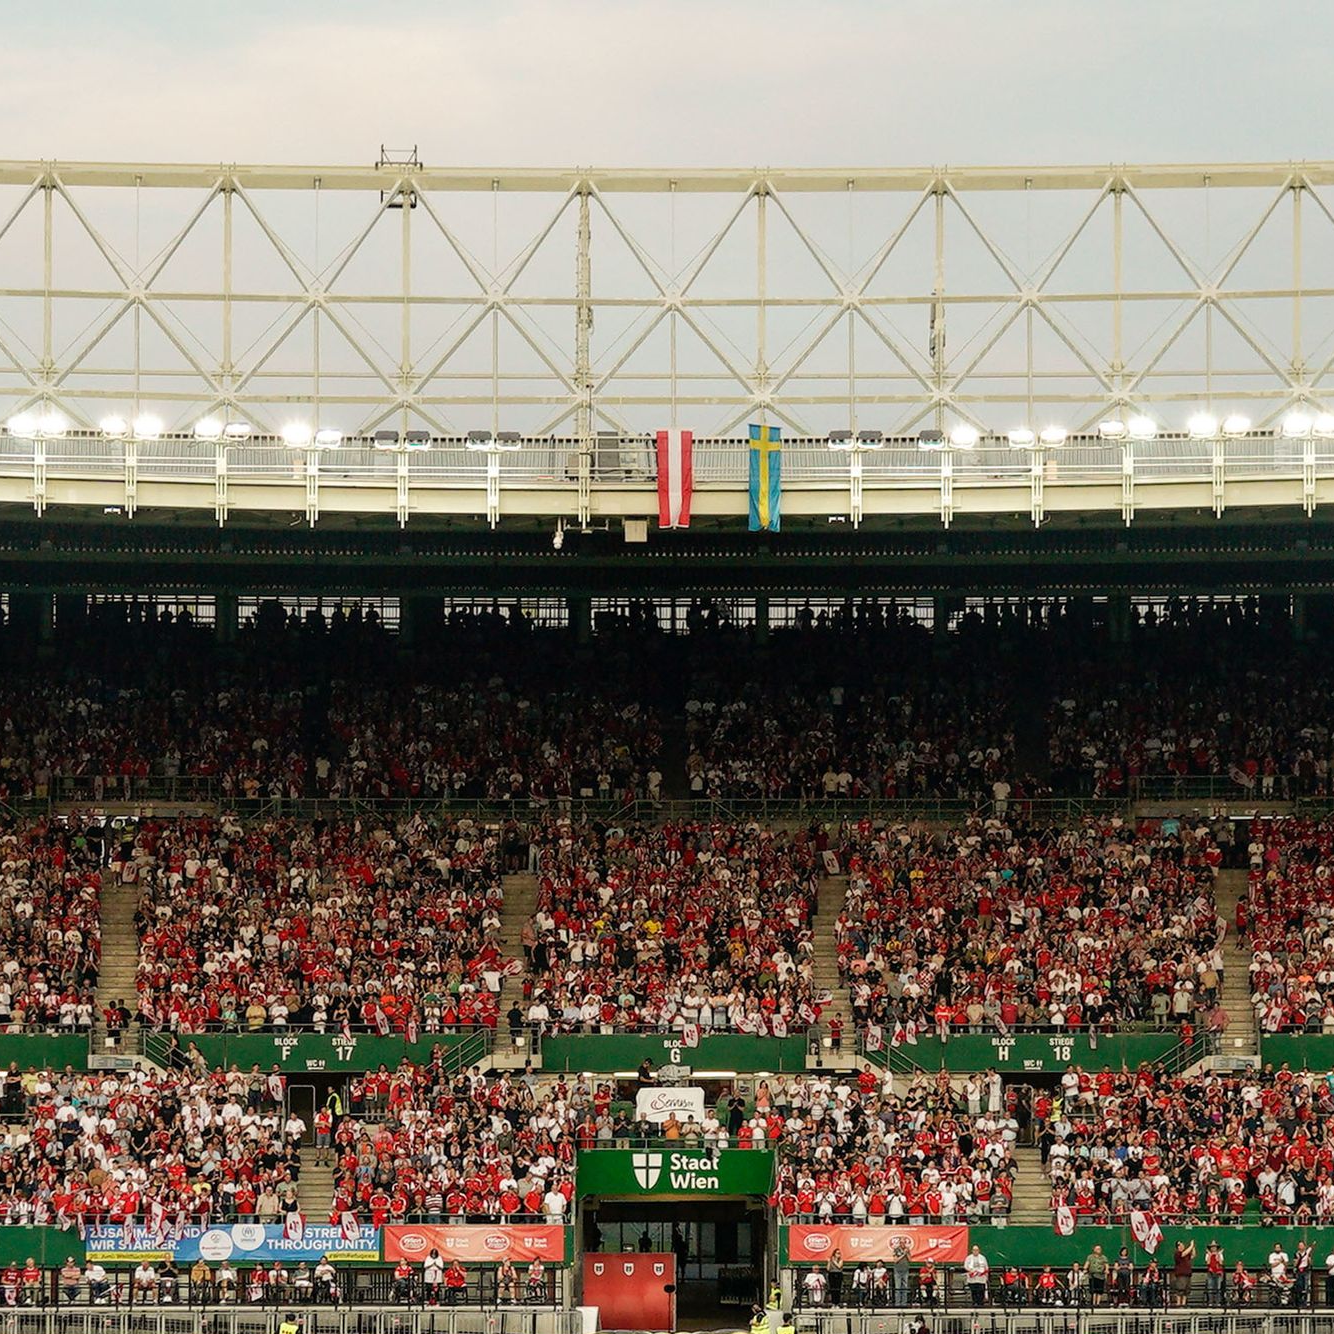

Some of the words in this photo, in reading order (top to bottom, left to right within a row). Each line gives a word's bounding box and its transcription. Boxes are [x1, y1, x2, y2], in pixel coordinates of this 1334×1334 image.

[274, 1038, 298, 1046] BLOCK
[664, 1040, 687, 1048] BLOC
[992, 1038, 1015, 1046] BLOCK
[1049, 1038, 1074, 1046] STIEGE
[336, 1046, 354, 1060] 17
[1054, 1046, 1071, 1060] 18
[670, 1173, 719, 1189] Wien
[90, 1240, 115, 1250] WIR
[267, 1239, 331, 1250] THROUGH
[335, 1239, 377, 1250] UNITY.
